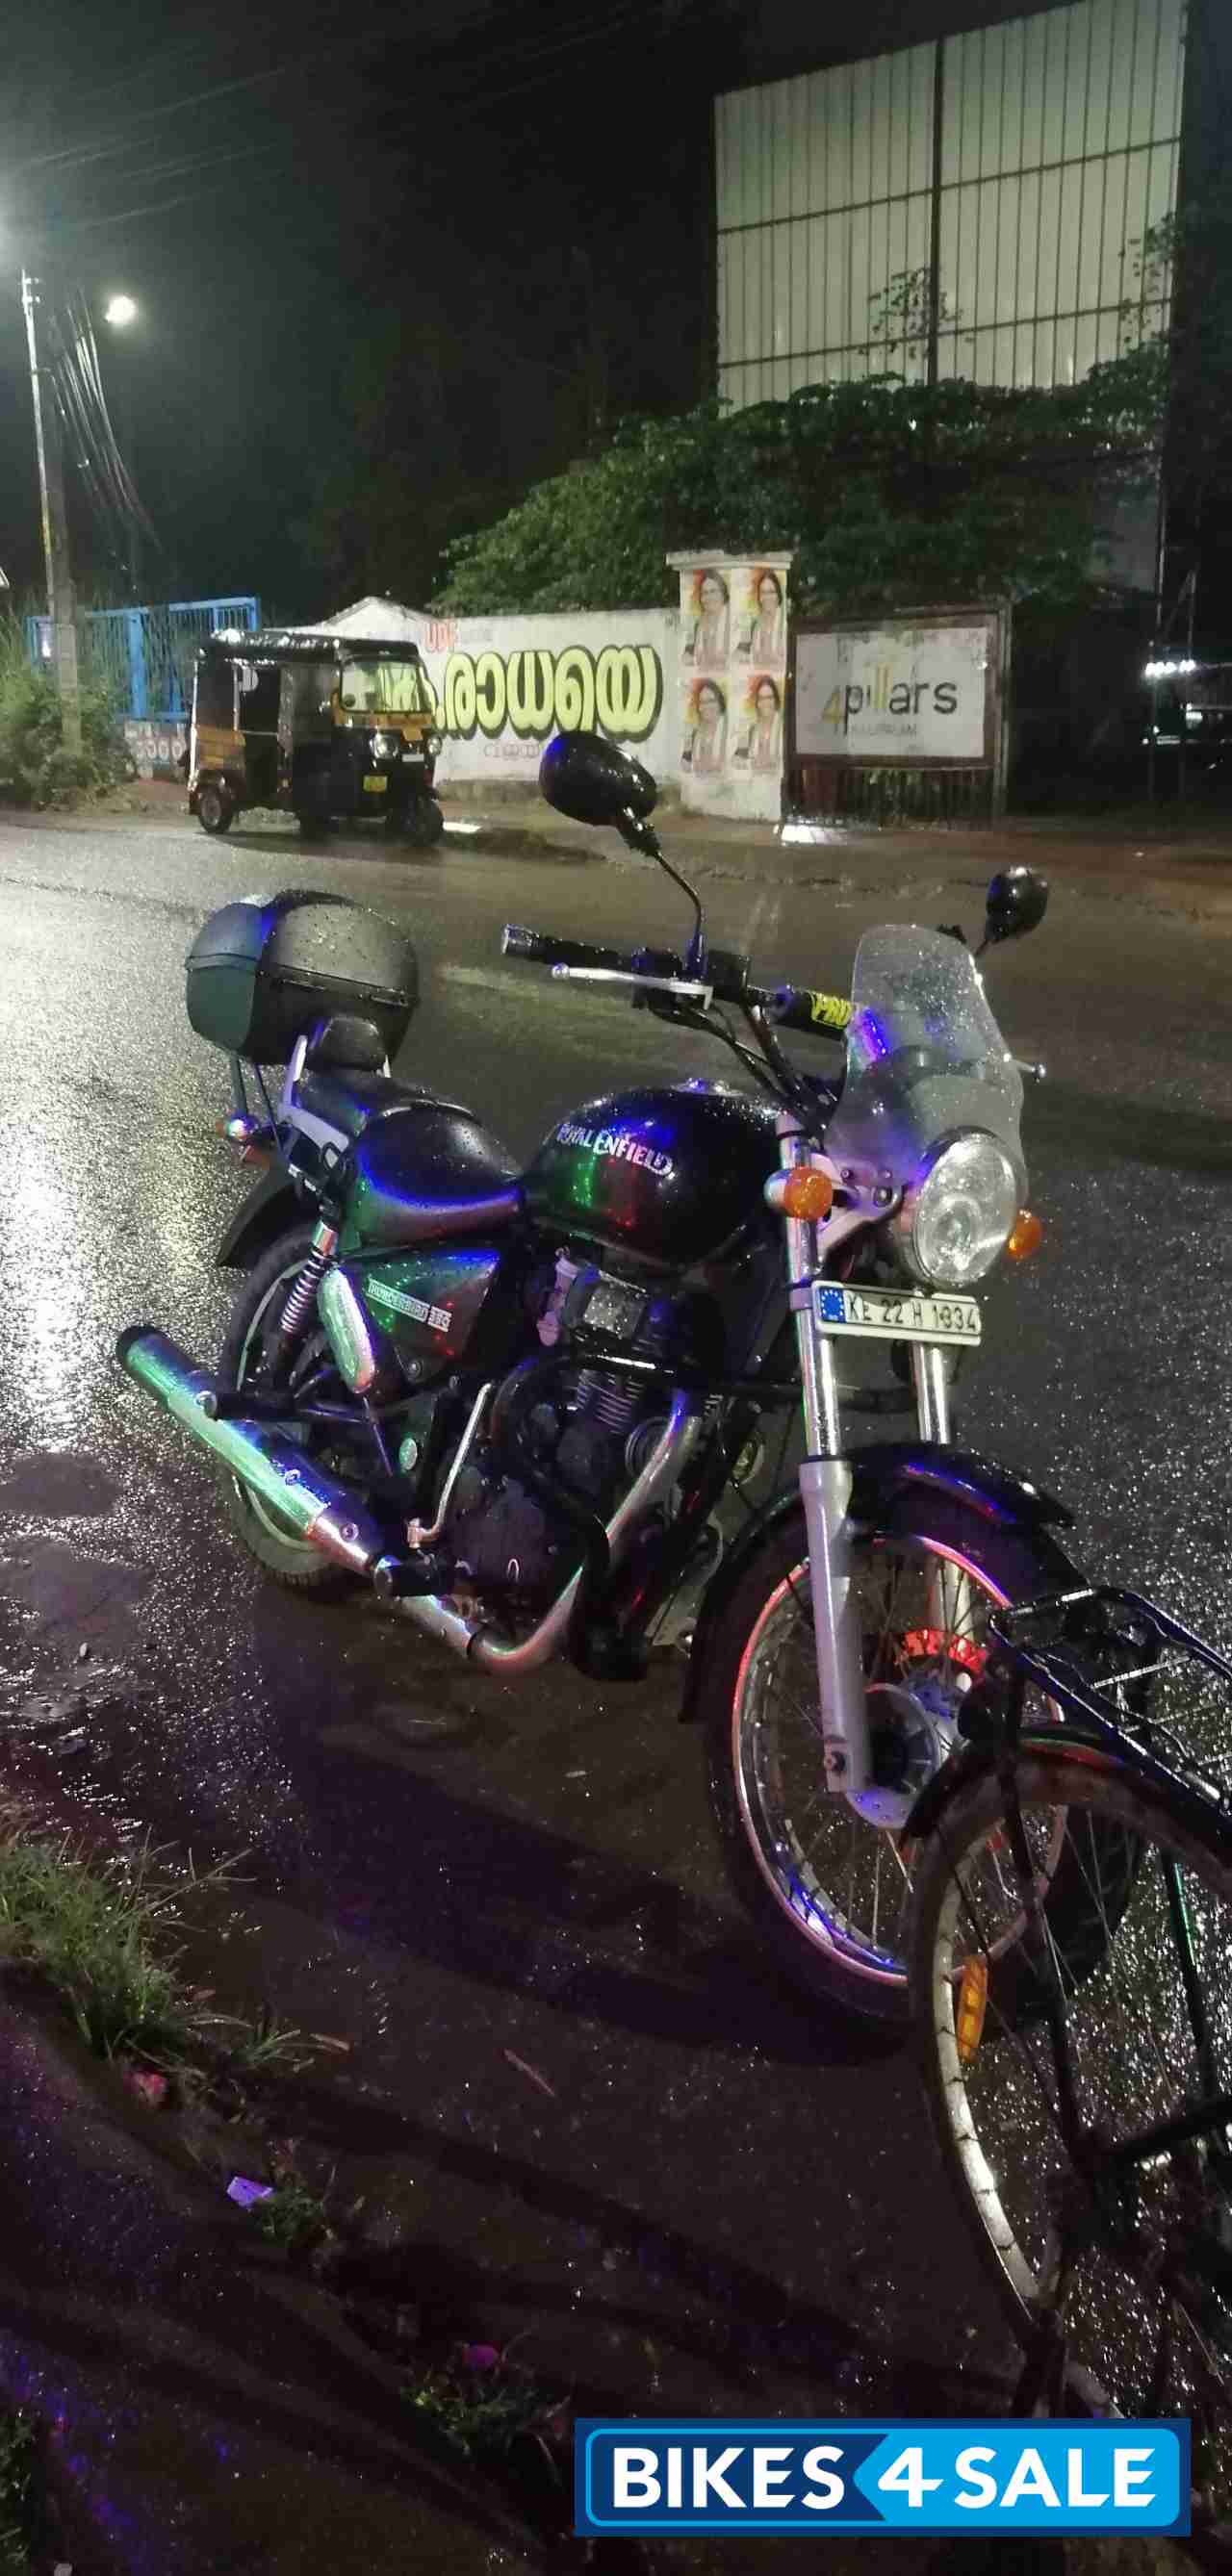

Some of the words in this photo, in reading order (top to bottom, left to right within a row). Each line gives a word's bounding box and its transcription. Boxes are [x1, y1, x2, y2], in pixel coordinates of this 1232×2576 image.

[592, 1129, 675, 1177] ENFIELD
[882, 1299, 904, 1324] 22
[911, 1300, 924, 1327] H
